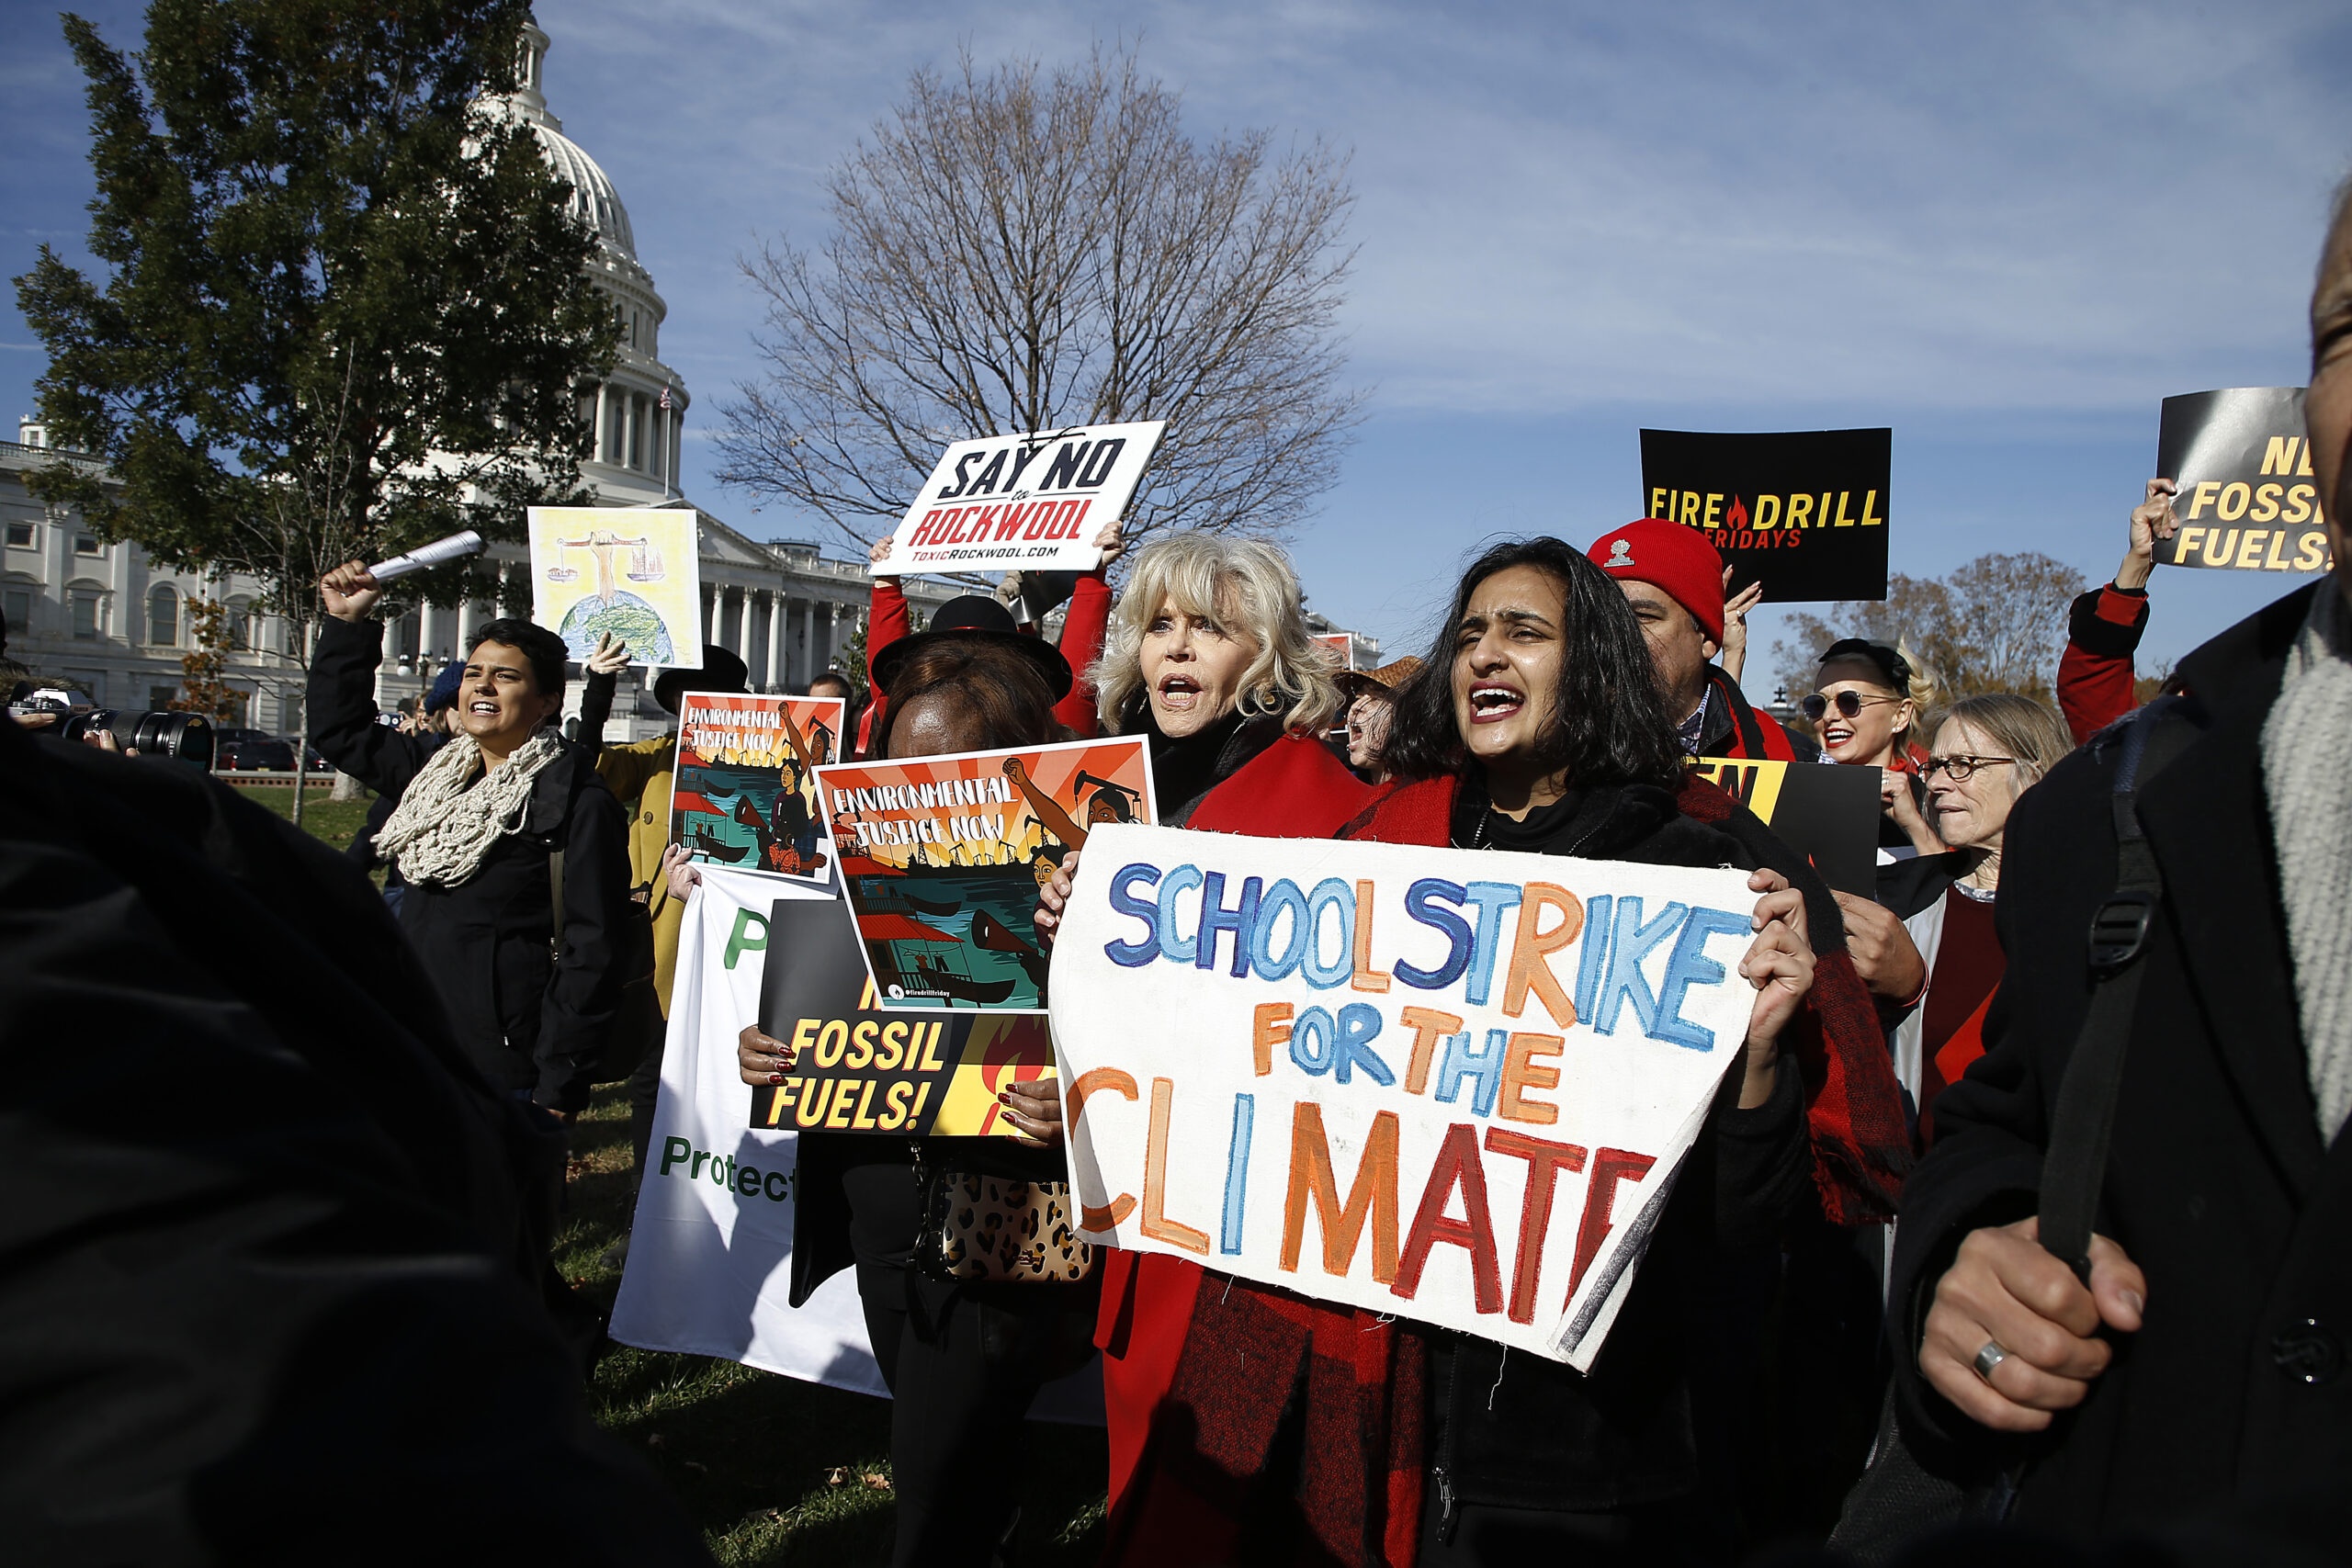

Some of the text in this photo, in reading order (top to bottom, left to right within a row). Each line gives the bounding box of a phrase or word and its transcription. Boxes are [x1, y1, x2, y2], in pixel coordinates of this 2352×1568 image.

[938, 438, 1126, 499] SAY NO
[1012, 490, 1033, 501] to
[1650, 487, 1883, 530] FIRE DRILL
[2187, 481, 2324, 524] FOSS
[909, 499, 1091, 547] ROCKWOOL
[687, 706, 783, 729] ENVIRONMENTAL
[692, 728, 774, 751] JUSTICE NOW
[831, 776, 1018, 814] ENVIRONMENTAL
[850, 814, 1004, 847] JUSTICE NOW
[1104, 863, 1752, 1052] SCHOOL STRIKE
[786, 1018, 944, 1072] FOSSIL
[1252, 1001, 1565, 1126] FOR THE
[766, 1077, 933, 1132] FUELS!
